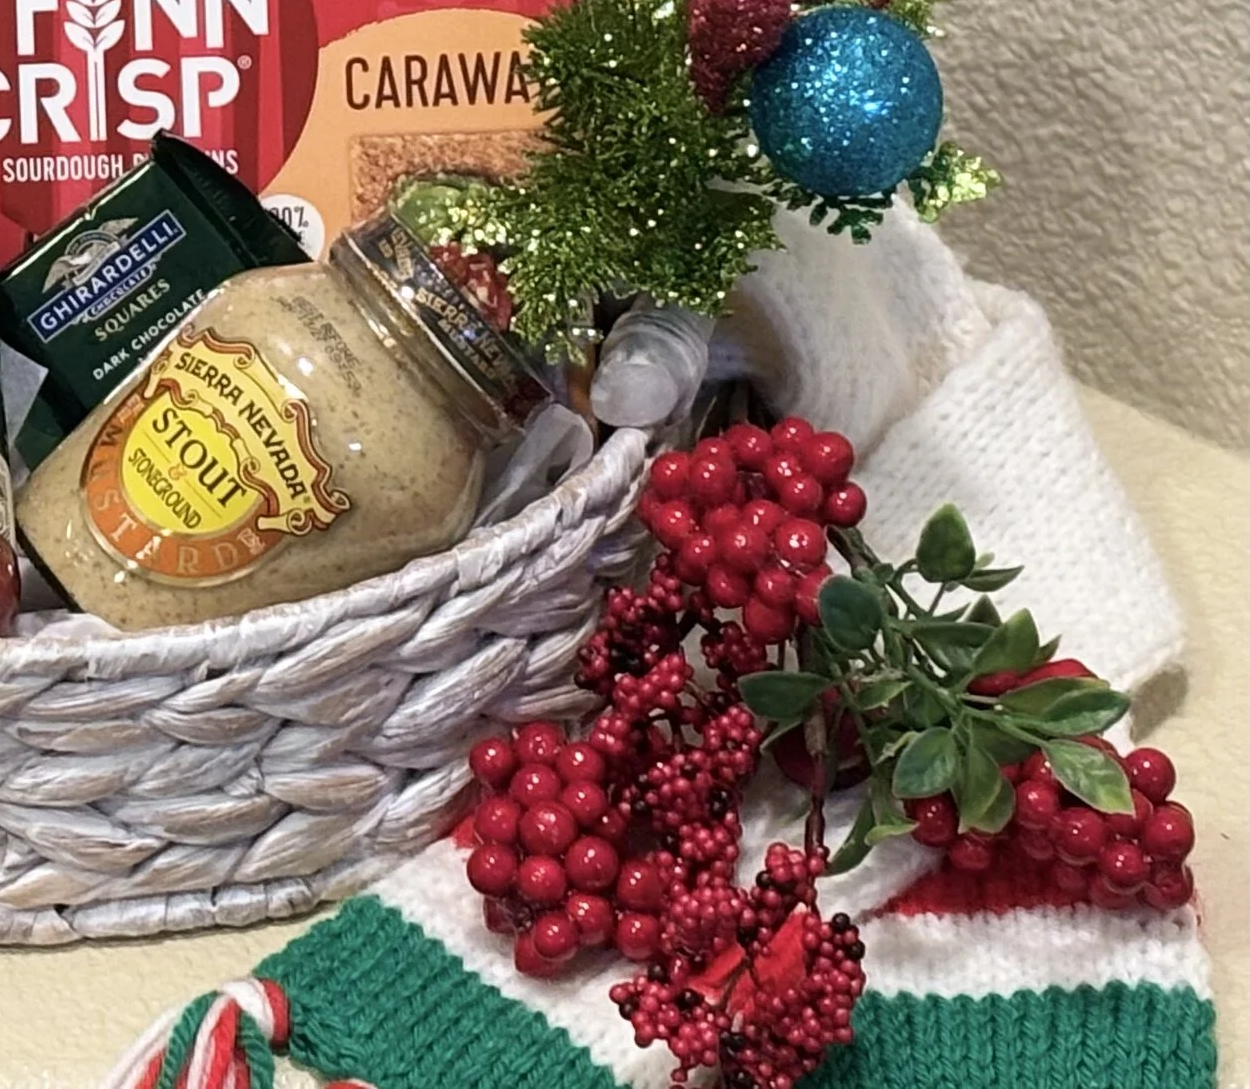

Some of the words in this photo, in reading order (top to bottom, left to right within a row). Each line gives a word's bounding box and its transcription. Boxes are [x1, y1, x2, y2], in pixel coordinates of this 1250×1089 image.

[344, 50, 532, 111] CARAWA
[2, 154, 124, 183] SOURDOUGH
[40, 221, 174, 331] GHIRARDELLI
[90, 267, 149, 316] CHOCOLATE
[94, 278, 171, 342] SQUARES
[92, 346, 131, 381] DARK
[130, 288, 206, 351] CHOCOLATE
[152, 406, 248, 509] STOUT
[173, 351, 244, 408] SIERRA
[238, 397, 307, 502] NEVADA
[127, 446, 203, 530] STONEGROUND
